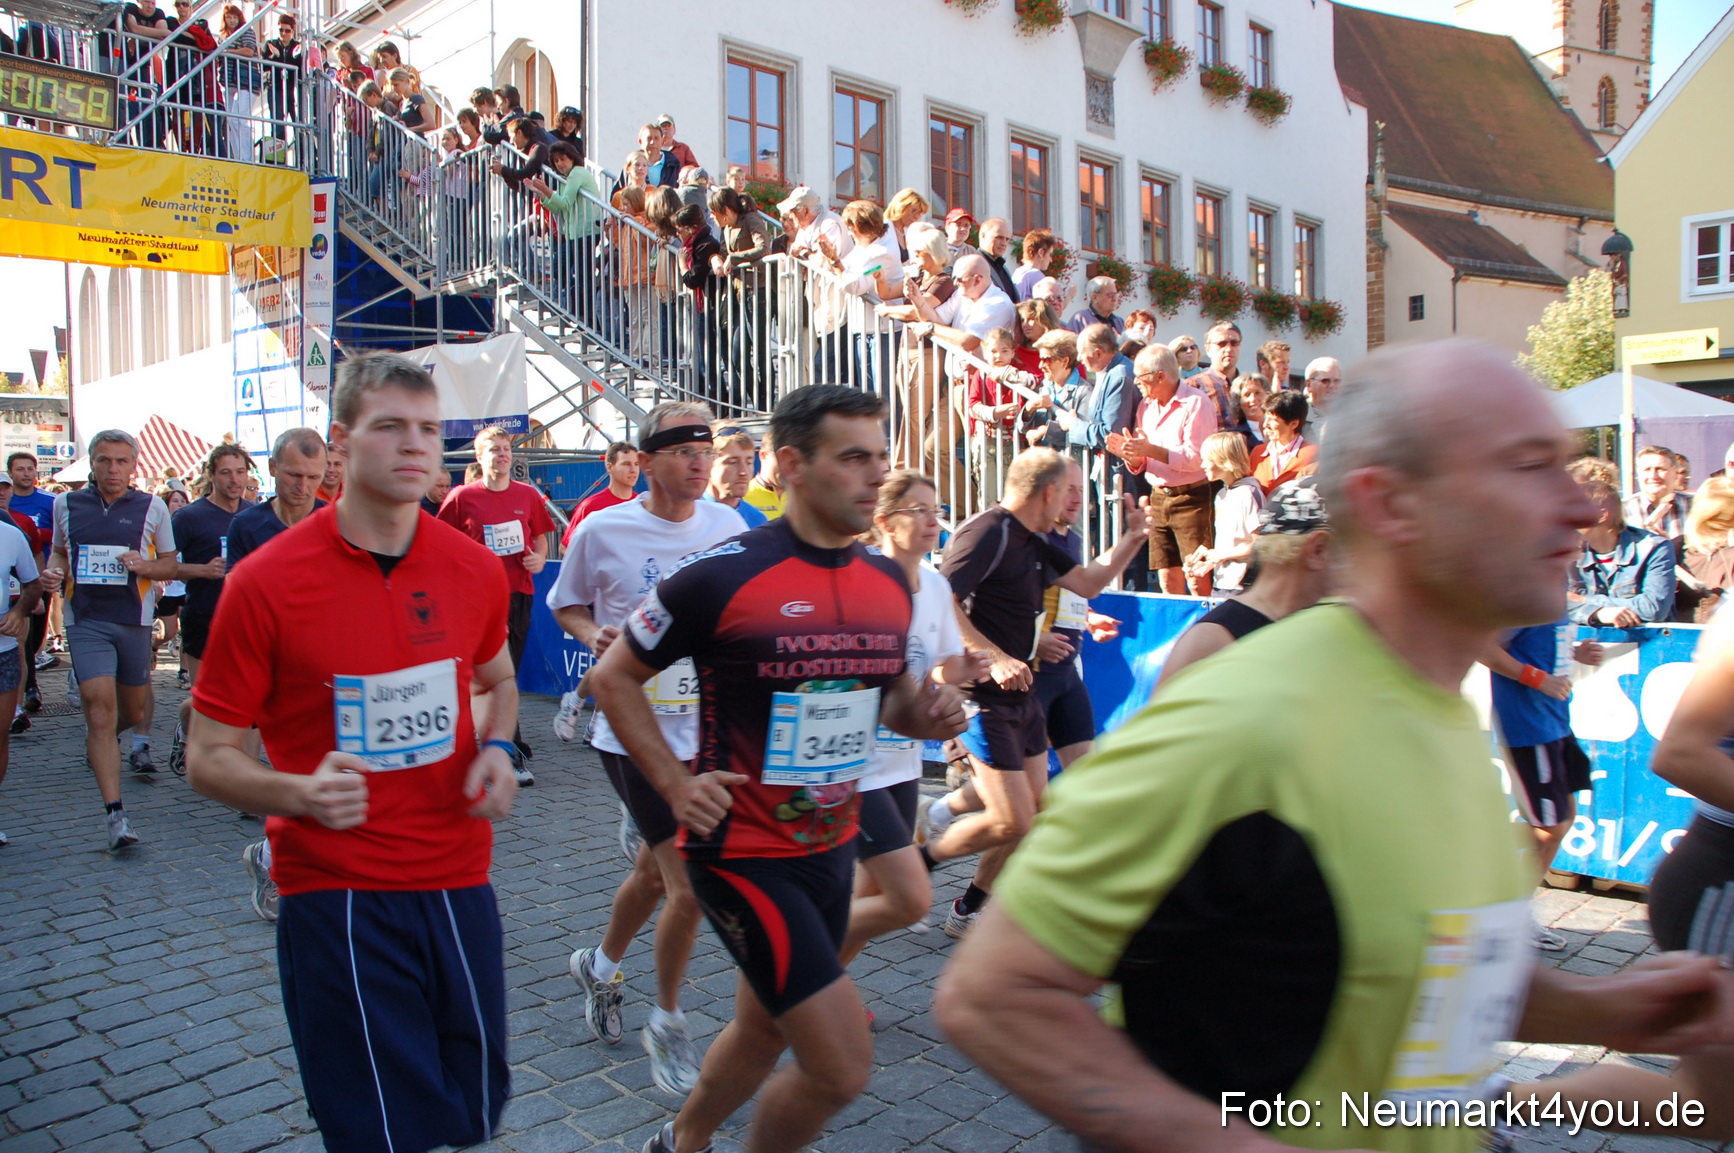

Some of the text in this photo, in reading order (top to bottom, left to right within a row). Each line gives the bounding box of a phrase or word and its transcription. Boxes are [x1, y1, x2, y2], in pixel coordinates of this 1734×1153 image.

[0, 147, 97, 209] RT
[141, 197, 276, 221] Neumarkter Stadtlauf
[515, 465, 525, 478] S
[497, 535, 521, 547] 2751
[90, 549, 110, 557] Josef
[92, 562, 125, 574] 2139
[371, 681, 428, 703] Jürgen
[376, 705, 451, 744] 2396
